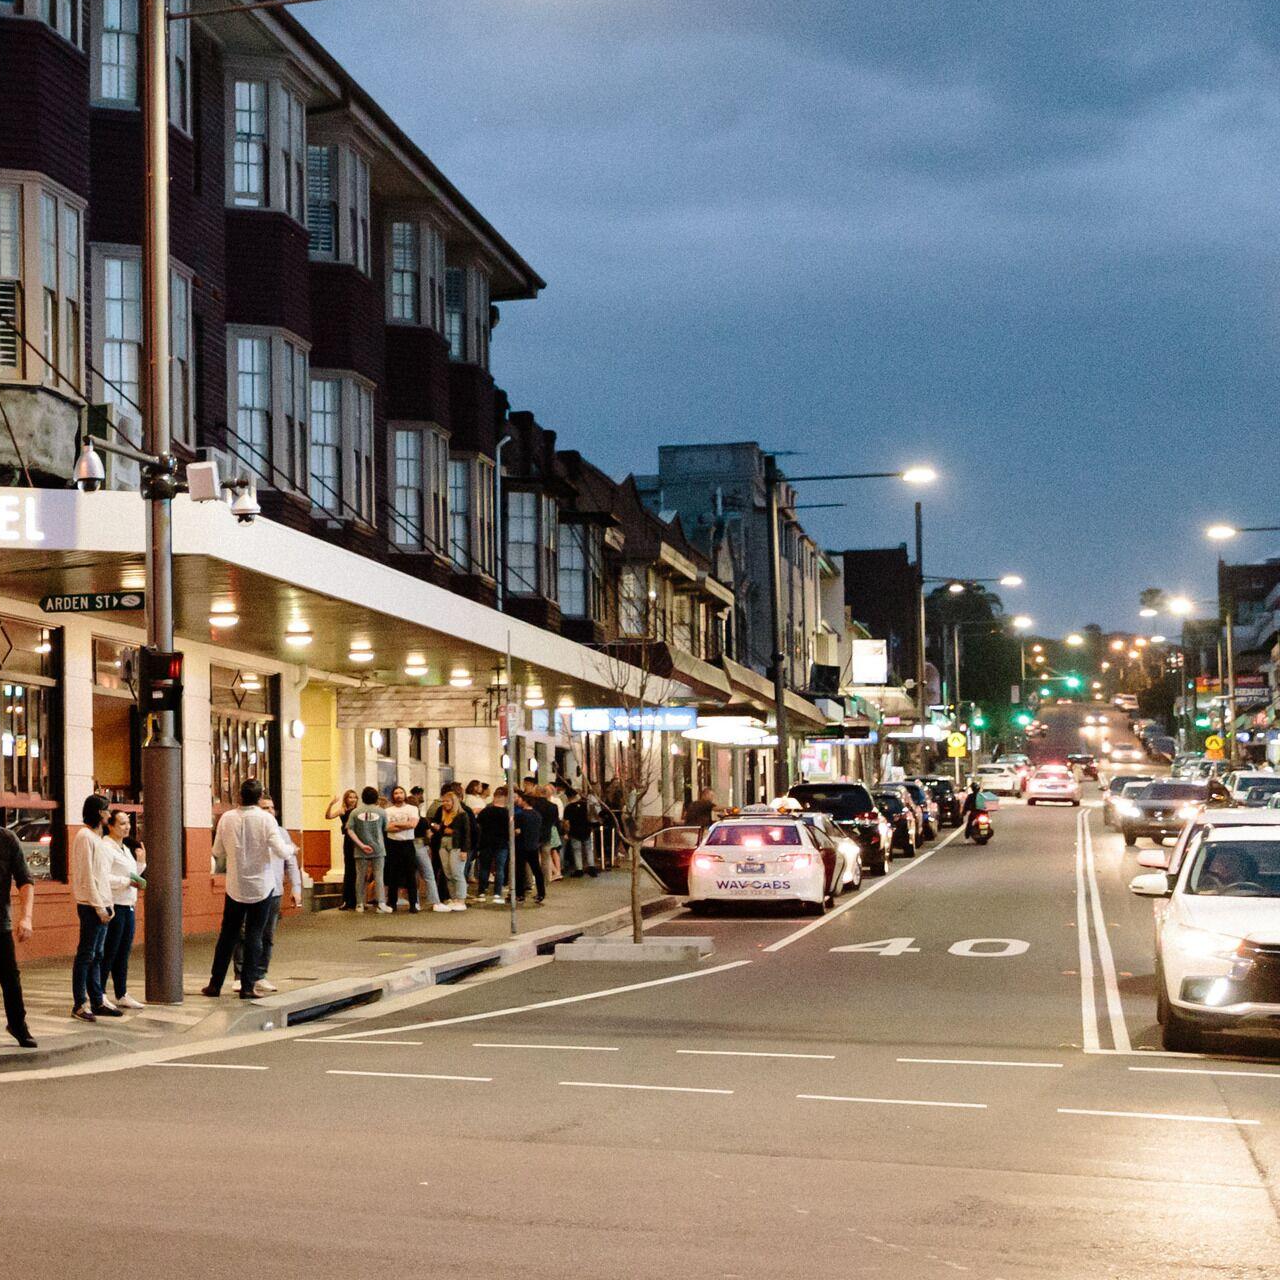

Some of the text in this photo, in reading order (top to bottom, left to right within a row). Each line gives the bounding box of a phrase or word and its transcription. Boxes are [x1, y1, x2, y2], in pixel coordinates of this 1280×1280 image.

[45, 595, 110, 611] ARDEN ST
[716, 880, 791, 890] WAV CABS
[828, 937, 1031, 958] 40
